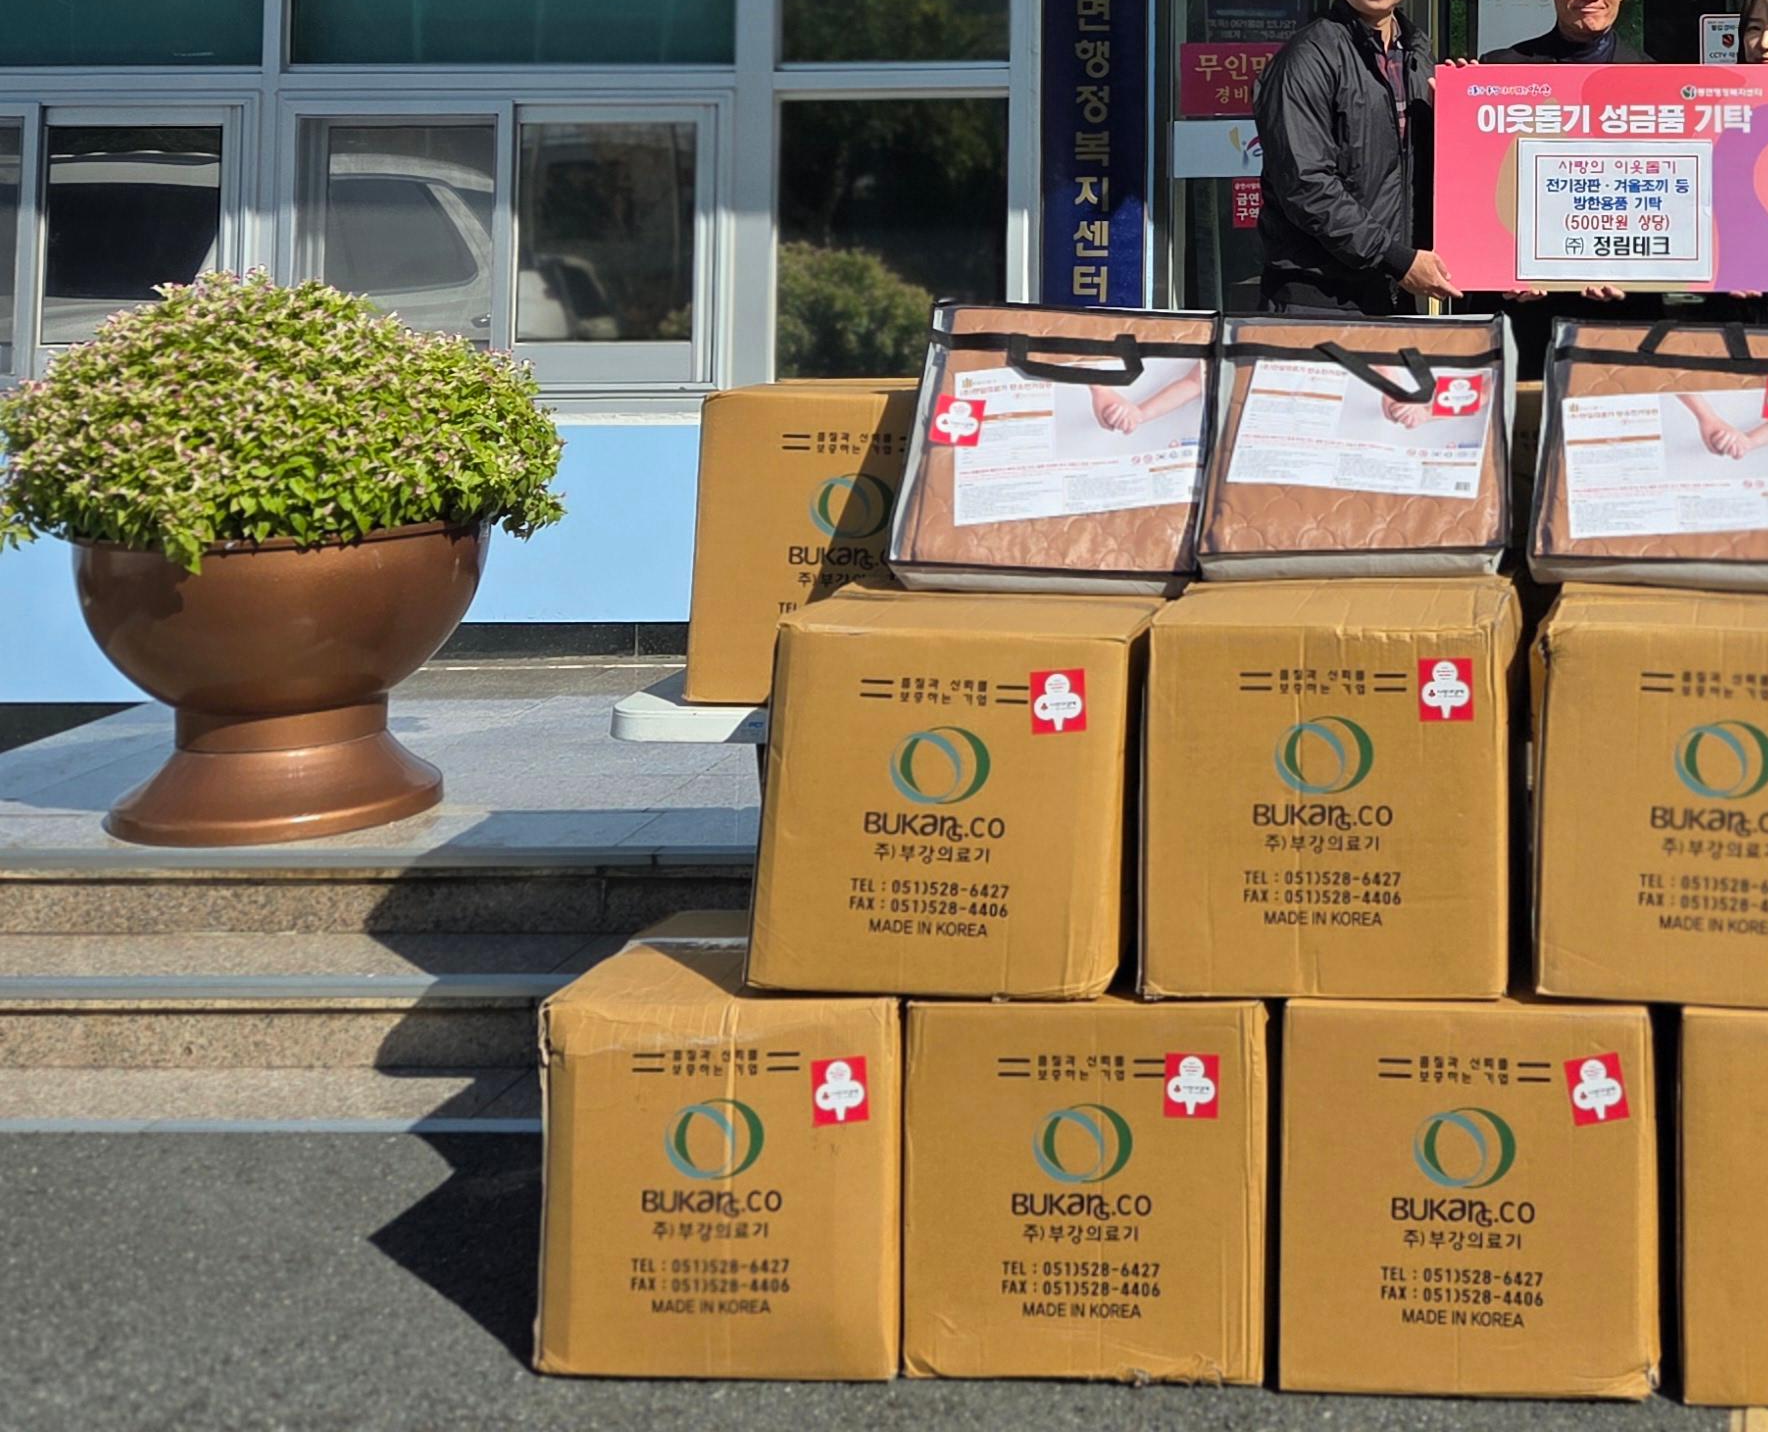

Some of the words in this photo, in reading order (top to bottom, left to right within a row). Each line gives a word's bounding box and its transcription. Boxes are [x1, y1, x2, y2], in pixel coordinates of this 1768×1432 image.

[1478, 104, 1590, 133] 이웃돕기
[1600, 104, 1684, 133] 성금품
[1694, 104, 1752, 133] 기탁
[1559, 160, 1604, 174] 사랑의
[1615, 160, 1676, 174] 이웃돕기
[1546, 178, 1600, 193] 전기장판
[1614, 179, 1668, 193] 겨울조끼
[1675, 179, 1689, 193] 등
[1236, 193, 1260, 206] 금연
[1574, 197, 1627, 210] 방한용품
[1635, 197, 1662, 210] 기탁
[1236, 208, 1259, 221] 구역
[1565, 215, 1627, 231] (500만원
[1638, 215, 1670, 231] 상당)
[1593, 236, 1670, 256] 정림테크
[1244, 871, 1268, 885] TEL
[1284, 871, 1400, 886] 051)528-6427
[1639, 874, 1664, 889] TEL
[851, 878, 875, 893] TEL
[892, 880, 1009, 898] 051)528-6427
[1244, 889, 1268, 902] FAX
[1284, 890, 1401, 905] 051)528-4406
[1639, 893, 1663, 907] FAX
[850, 896, 874, 910] FAX
[891, 900, 1008, 918] 051)528-4406
[1264, 912, 1308, 925] MADE
[1312, 912, 1326, 925] IN
[1331, 912, 1382, 926] KOREA
[1659, 916, 1704, 930] MADE
[1709, 917, 1723, 932] IN
[869, 919, 913, 934] MADE
[918, 921, 931, 935] IN
[937, 922, 988, 936] KOREA
[632, 1259, 655, 1273] TEL
[672, 1259, 789, 1274] 051)528-6427
[1002, 1261, 1027, 1276] TEL
[1043, 1262, 1159, 1277] 051)528-6427
[1382, 1267, 1405, 1281] TEL
[1423, 1268, 1543, 1286] 051)528-6427
[632, 1277, 655, 1291] FAX
[672, 1278, 789, 1293] 051)528-4406
[1002, 1280, 1027, 1294] FAX
[1043, 1281, 1160, 1297] 051)528-4406
[1382, 1286, 1406, 1300] FAX
[1423, 1287, 1543, 1306] 051)528-4406
[652, 1300, 695, 1313] MADE
[700, 1300, 714, 1313] IN
[719, 1299, 770, 1314] KOREA
[1023, 1303, 1066, 1317] MADE
[1071, 1304, 1084, 1317] IN
[1090, 1304, 1141, 1318] KOREA
[1402, 1310, 1447, 1325] MADE
[1452, 1311, 1466, 1326] IN
[1472, 1312, 1524, 1328] KOREA
